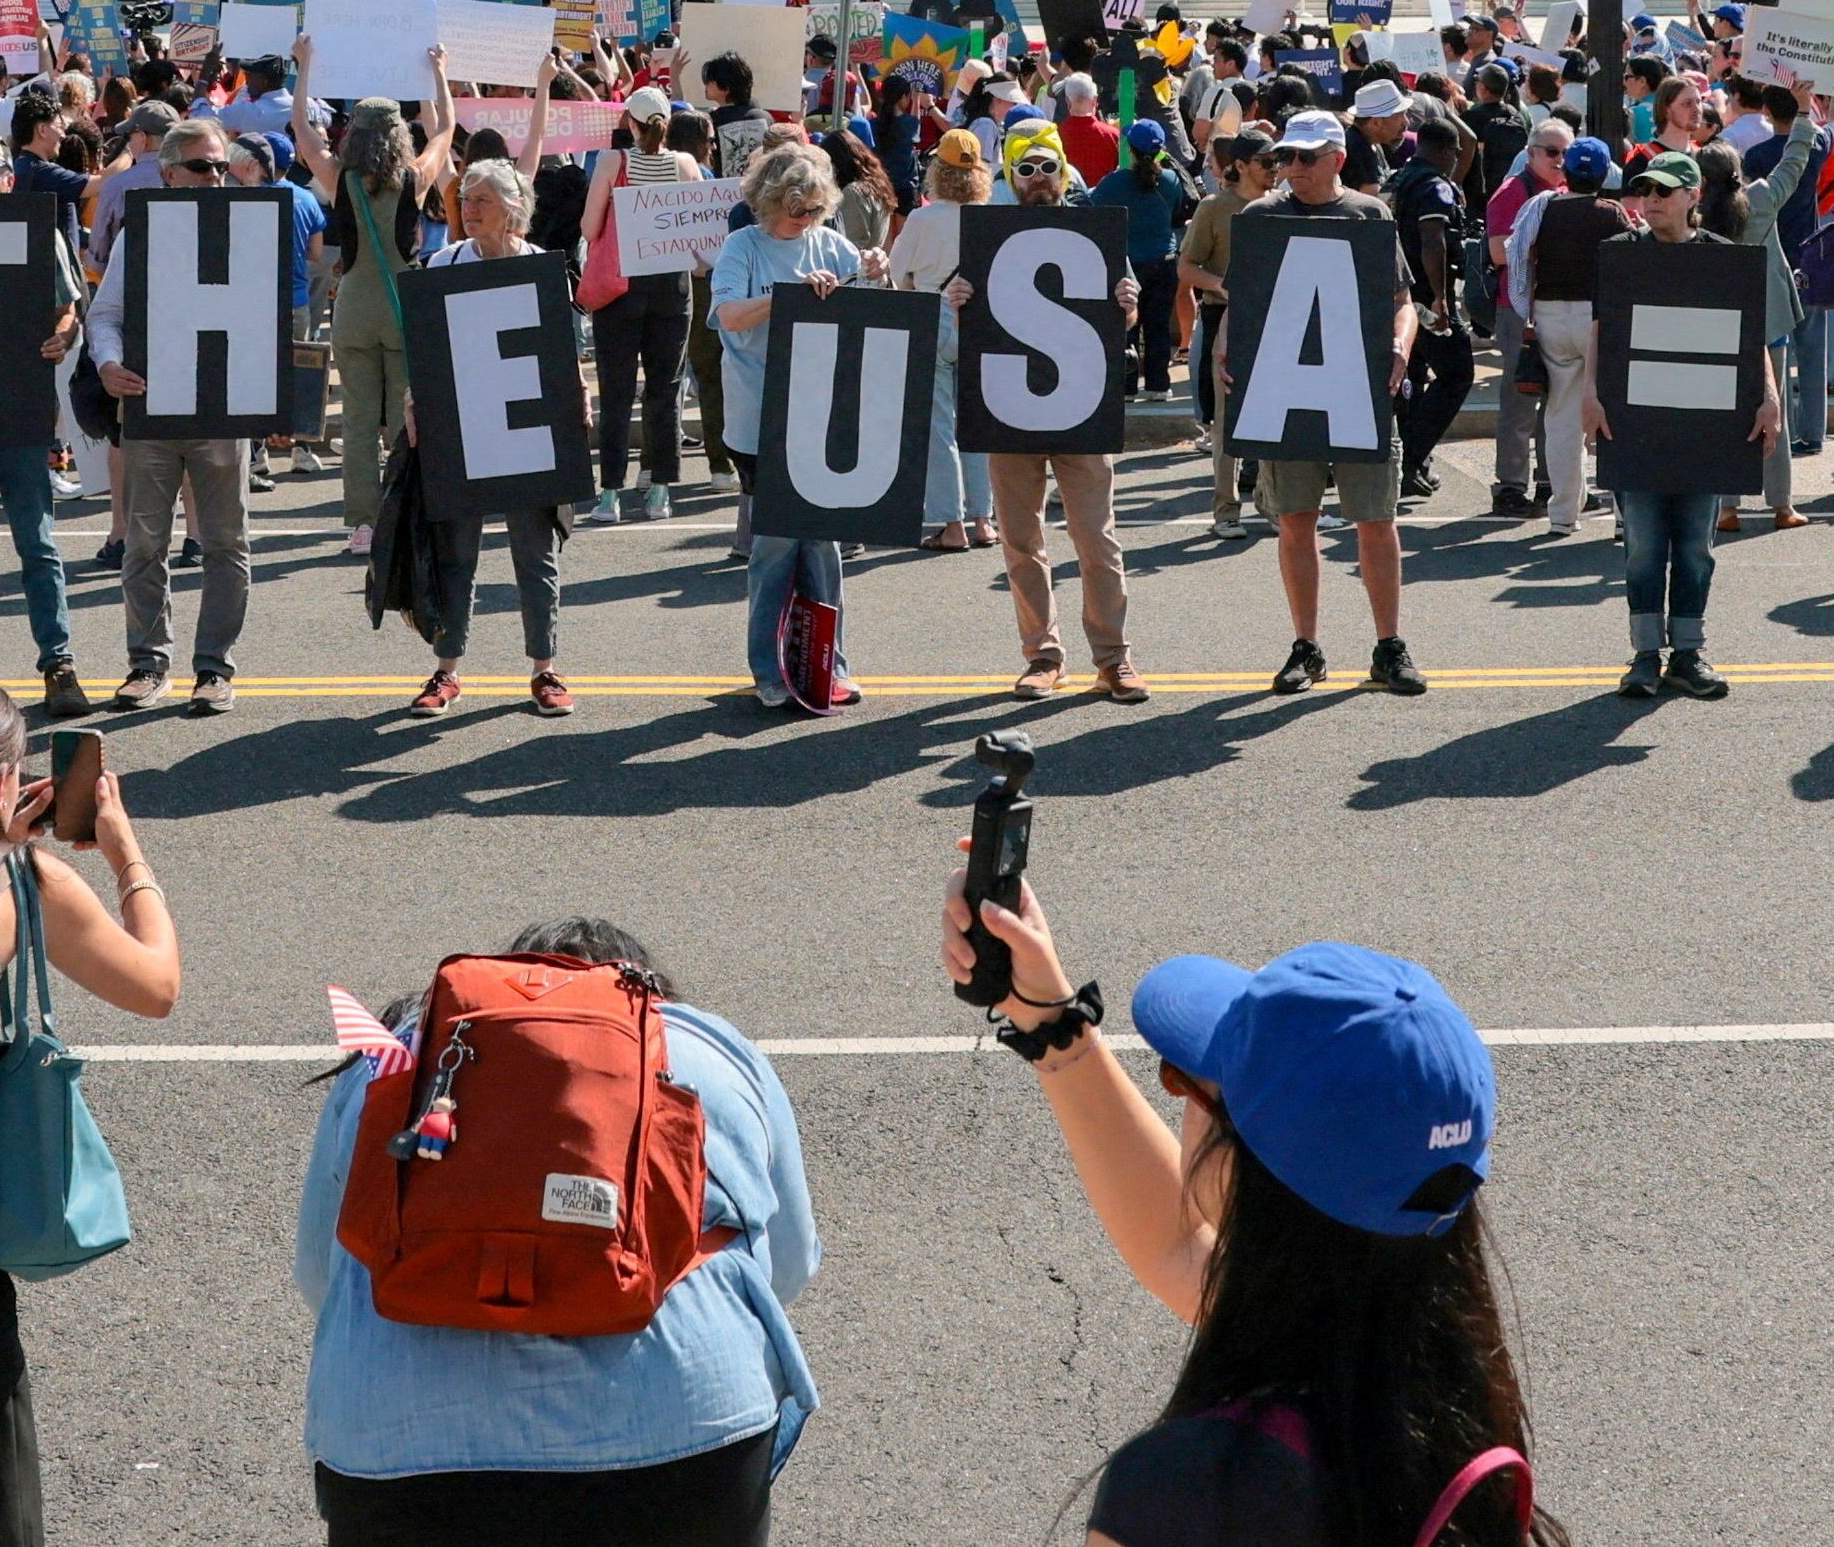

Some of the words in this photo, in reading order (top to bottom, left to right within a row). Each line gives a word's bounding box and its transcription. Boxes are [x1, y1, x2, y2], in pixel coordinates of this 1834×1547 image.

[1, 6, 34, 16] NUESTRAS
[1756, 41, 1776, 54] the
[1766, 31, 1787, 43] It's
[1788, 37, 1834, 53] literally
[917, 59, 942, 80] HERE
[633, 188, 704, 214] NACIDO
[710, 186, 742, 204] AQU
[146, 201, 278, 416] H
[980, 227, 1108, 431] S
[1232, 235, 1379, 451] A
[444, 282, 556, 479] E
[786, 322, 910, 508] U
[797, 608, 813, 693] AMENDMENT
[822, 643, 830, 671] ACLU
[1428, 1119, 1472, 1150] ACLU
[551, 1187, 592, 1201] NORTH
[571, 1180, 590, 1192] THE
[561, 1198, 591, 1211] FACE
